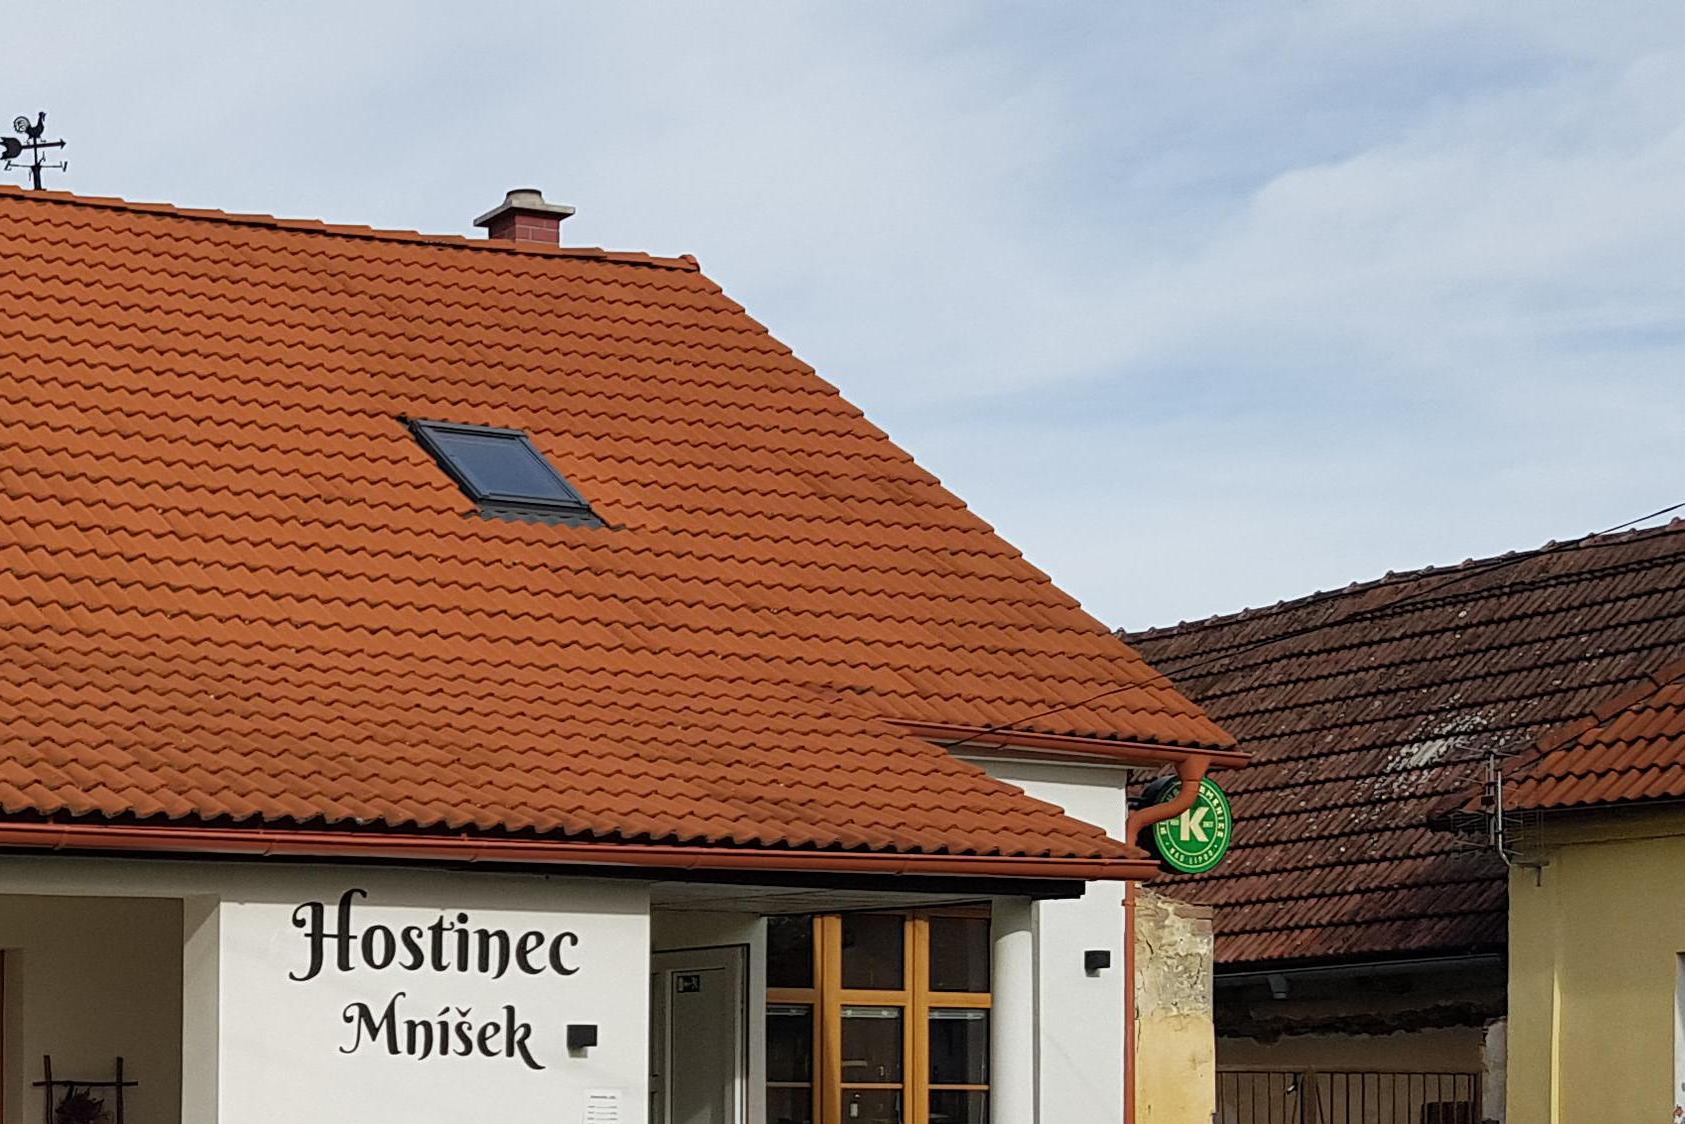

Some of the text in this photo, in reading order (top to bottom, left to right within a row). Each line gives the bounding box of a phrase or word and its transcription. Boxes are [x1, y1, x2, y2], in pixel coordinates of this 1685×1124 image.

[1180, 806, 1210, 842] K
[289, 888, 580, 982] Hostinec
[339, 991, 547, 1070] Mníšek
